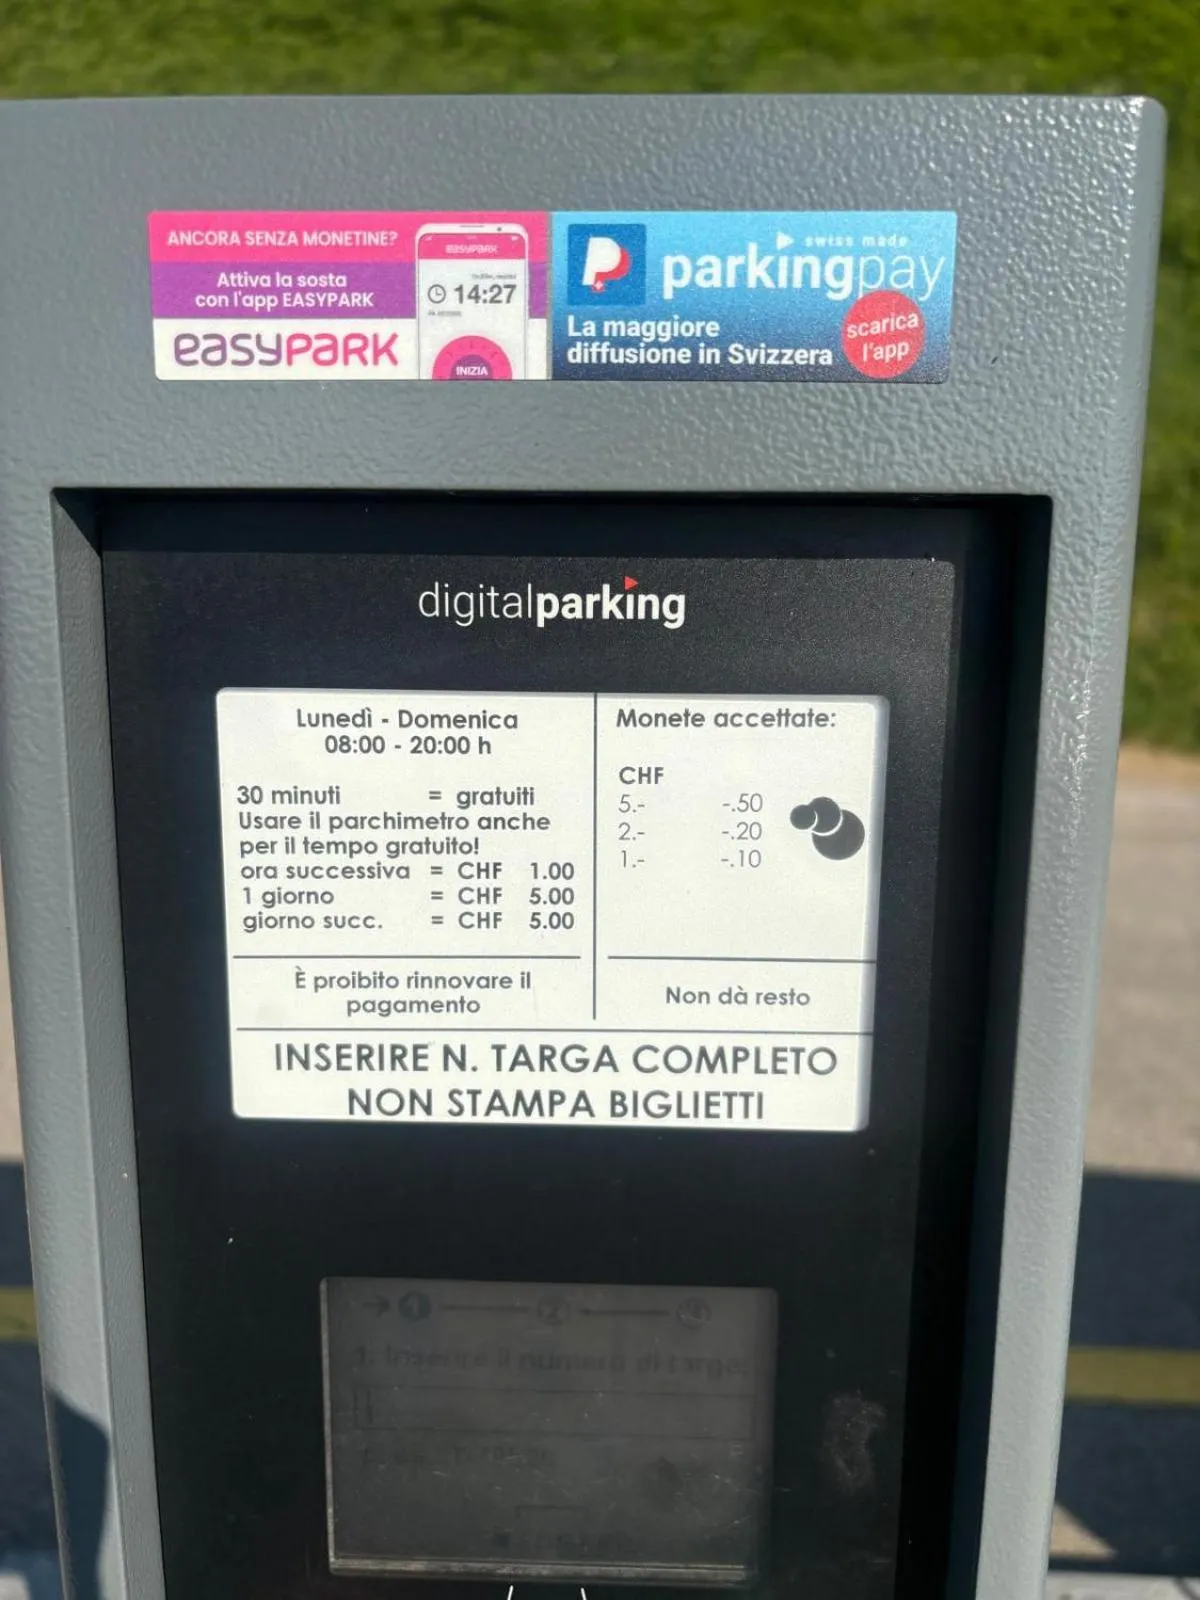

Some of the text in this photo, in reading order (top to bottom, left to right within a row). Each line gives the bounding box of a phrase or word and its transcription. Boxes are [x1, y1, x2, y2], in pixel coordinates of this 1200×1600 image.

[167, 229, 398, 247] ANCORA SENZA MONETINE?
[804, 233, 909, 247] swiss made
[216, 272, 347, 288] Attiva la sosta
[663, 241, 946, 301] parkingpay
[195, 292, 374, 312] con l'app EASYPARK
[453, 284, 517, 304] 14:27
[567, 316, 720, 342] La maggiore
[847, 312, 919, 339] scarica
[567, 342, 833, 365] diffusione in Svizzera
[863, 341, 910, 363] l'app
[456, 366, 488, 376] INIZIA
[418, 578, 686, 629] digitalparking
[297, 707, 373, 729] Lunedì
[398, 709, 518, 729] Domenica
[616, 708, 836, 728] Monete accettate:
[324, 735, 385, 754] 08:00
[410, 736, 470, 755] 20:00
[479, 735, 491, 754] h
[618, 766, 664, 785] CHF
[236, 785, 263, 805] 30
[271, 785, 341, 805] minuti
[456, 786, 535, 809] gratuiti
[618, 793, 763, 813] 5.- -.50
[238, 811, 551, 835] Usare il parchimetro anche
[618, 821, 763, 841] 2.- -.20
[240, 836, 479, 859] per il tempo gratuito!
[621, 849, 762, 868] 1.- -.10
[240, 864, 278, 880] ora
[286, 861, 410, 880] successiva
[458, 861, 503, 880] CHF
[530, 862, 575, 880] 1.00
[243, 888, 252, 905] 1
[261, 886, 334, 908] giorno
[458, 887, 503, 905] CHF
[529, 887, 575, 905] 5.00
[243, 911, 314, 933] giorno
[323, 914, 383, 930] succ.
[458, 912, 503, 930] CHF
[529, 912, 575, 930] 5.00
[295, 965, 531, 993] È proibito rinnovare il
[665, 985, 811, 1006] Non dà resto
[347, 996, 480, 1017] pagamento
[275, 1043, 838, 1075] INSERIRE N. TARGA COMPLETO
[348, 1088, 764, 1119] NON STAMPA BIGLIETTI
